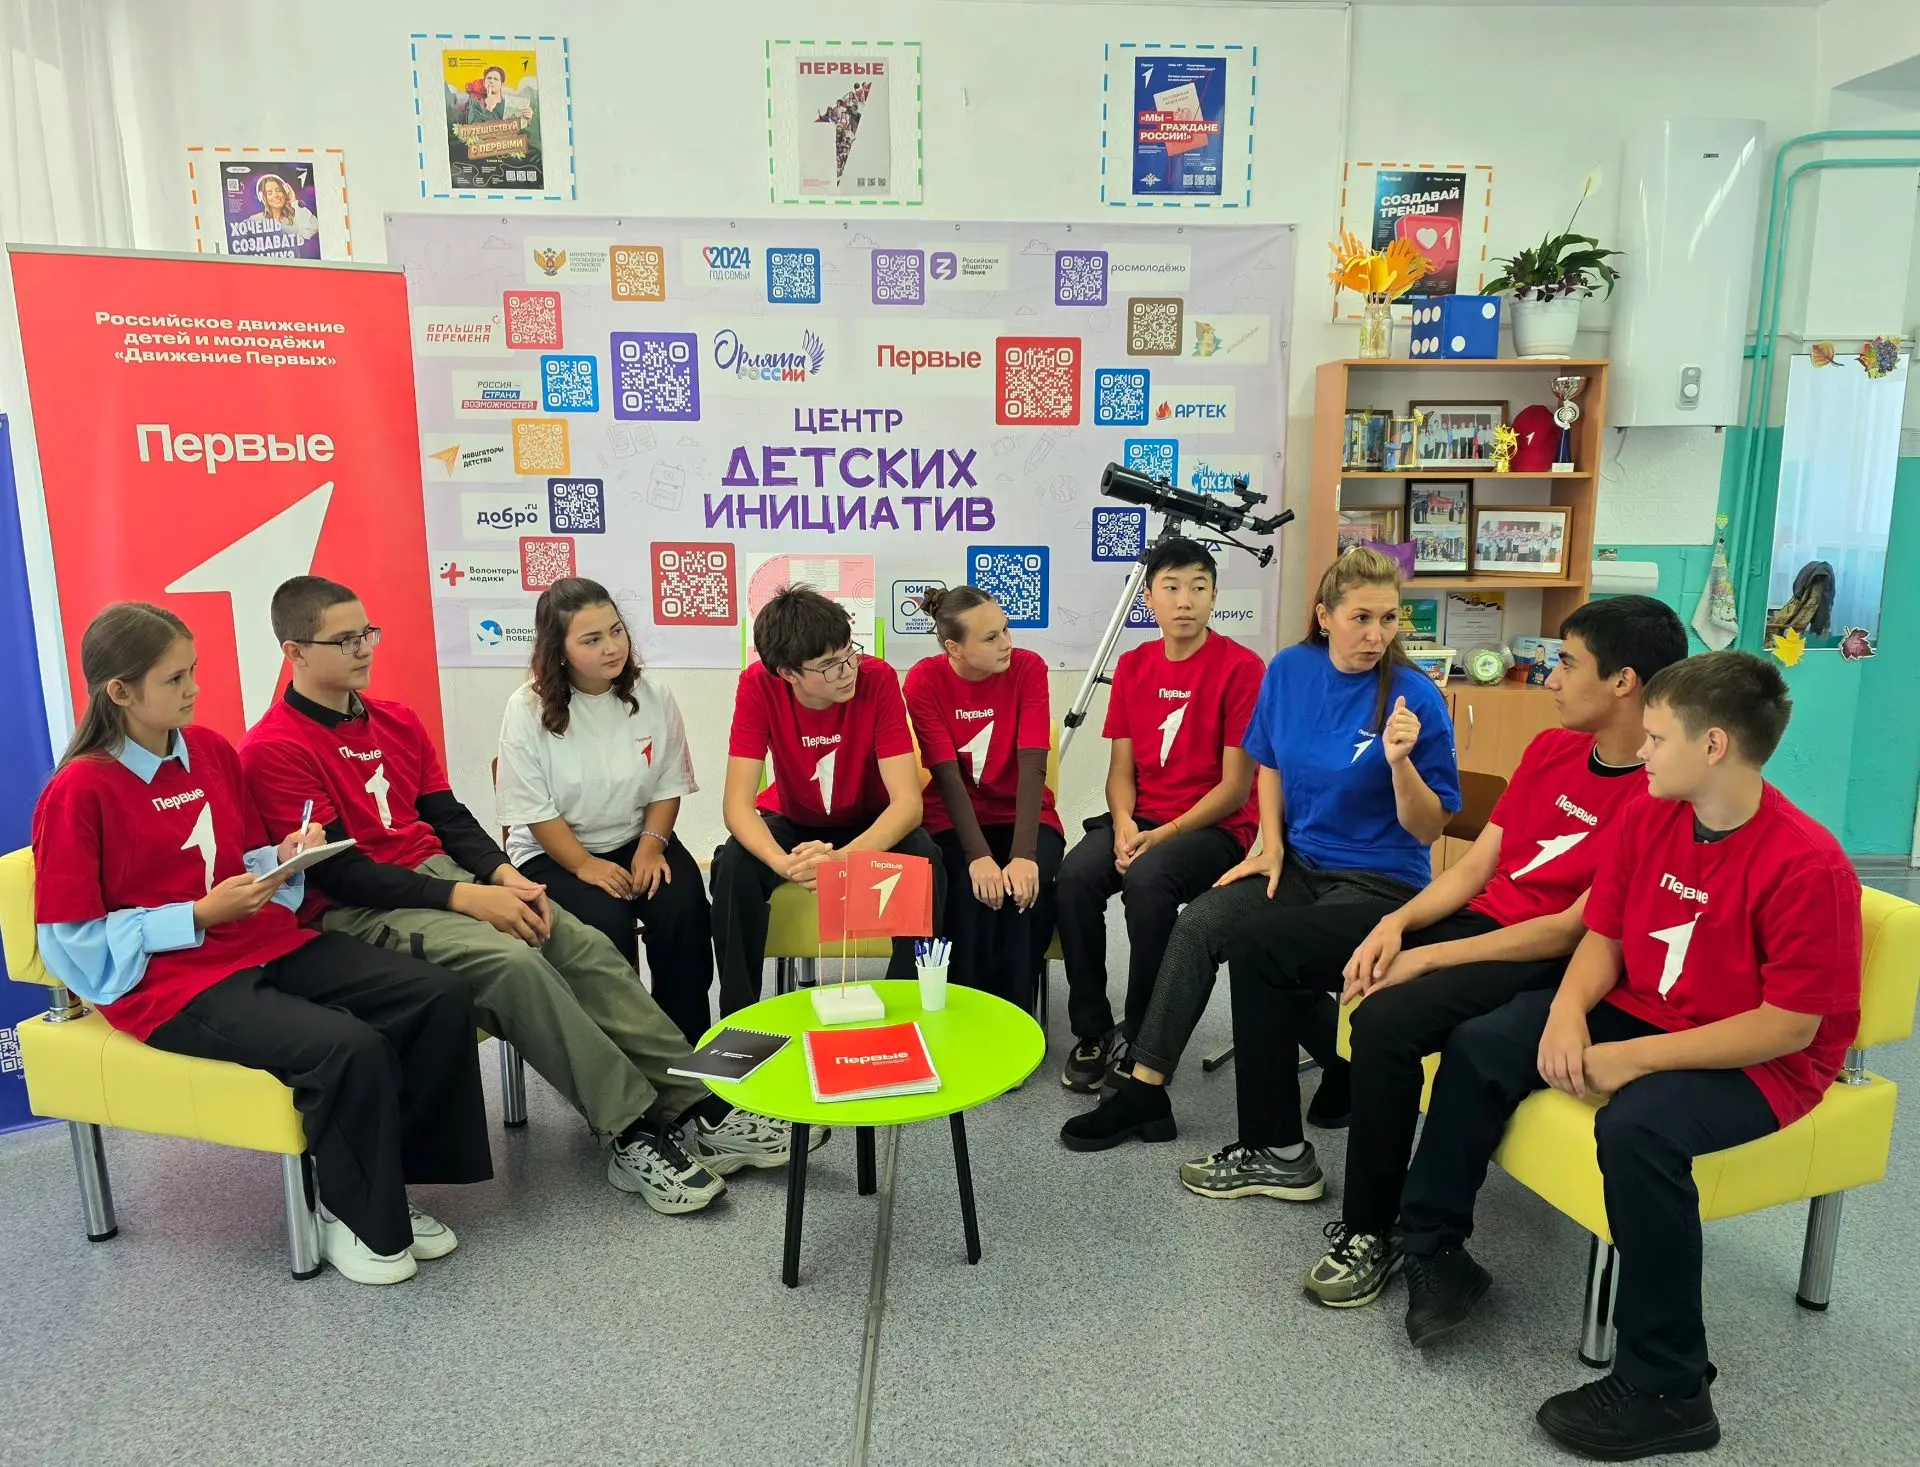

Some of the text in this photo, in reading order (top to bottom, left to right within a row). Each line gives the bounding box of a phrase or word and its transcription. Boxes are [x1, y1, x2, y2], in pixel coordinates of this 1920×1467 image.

[799, 62, 884, 75] ПЕРВЫЕ
[1140, 114, 1164, 122] «МЫ
[460, 120, 518, 138] ПУТЕШЕСТВУЙ
[1160, 123, 1218, 132] ГРАЖДАНЕ
[1140, 132, 1191, 140] РОССИИ!»
[471, 139, 523, 155] С ПЕРВЫМИ
[1380, 186, 1460, 206] СОЗДАВАЙ
[1379, 202, 1439, 217] ТРЕНДЫ
[229, 218, 282, 237] ХОЧЕШЬ
[231, 233, 305, 253] СОЗДАВАТЬ
[709, 246, 752, 269] 2024
[709, 270, 723, 281] ГОД
[1110, 263, 1186, 274] росмолодёжь
[95, 311, 346, 334] Российское движение
[427, 323, 492, 333] БОЛЬШАЯ
[124, 332, 326, 350] детей и молодёжи
[426, 333, 491, 343] ПЕРЕМЕНА
[114, 347, 337, 367] «Движение Первых»
[713, 328, 806, 375] Орлята
[876, 344, 983, 375] Первые
[477, 381, 512, 389] РОССИЯ
[483, 391, 518, 399] СТРАНА
[463, 400, 534, 409] ВОЗМОЖНОСТЕЙ
[1174, 404, 1227, 418] АРТЕК
[794, 407, 903, 434] ЦЕНТР
[135, 423, 335, 475] Первые
[461, 445, 504, 460] НАВИГАТОРЫ
[463, 457, 492, 468] ДЕТСТВА
[721, 445, 978, 489] ДЕТСКИХ
[703, 493, 996, 534] ИНИЦИАТИВ
[469, 565, 519, 577] Волонтеры
[1211, 608, 1254, 621] ириус
[1159, 688, 1191, 701] Первые
[955, 707, 994, 722] Первые
[801, 733, 841, 748] Первые
[152, 787, 205, 812] Первые
[1555, 794, 1598, 826] Первые
[870, 860, 904, 870] Первые
[835, 1051, 909, 1065] Первые
